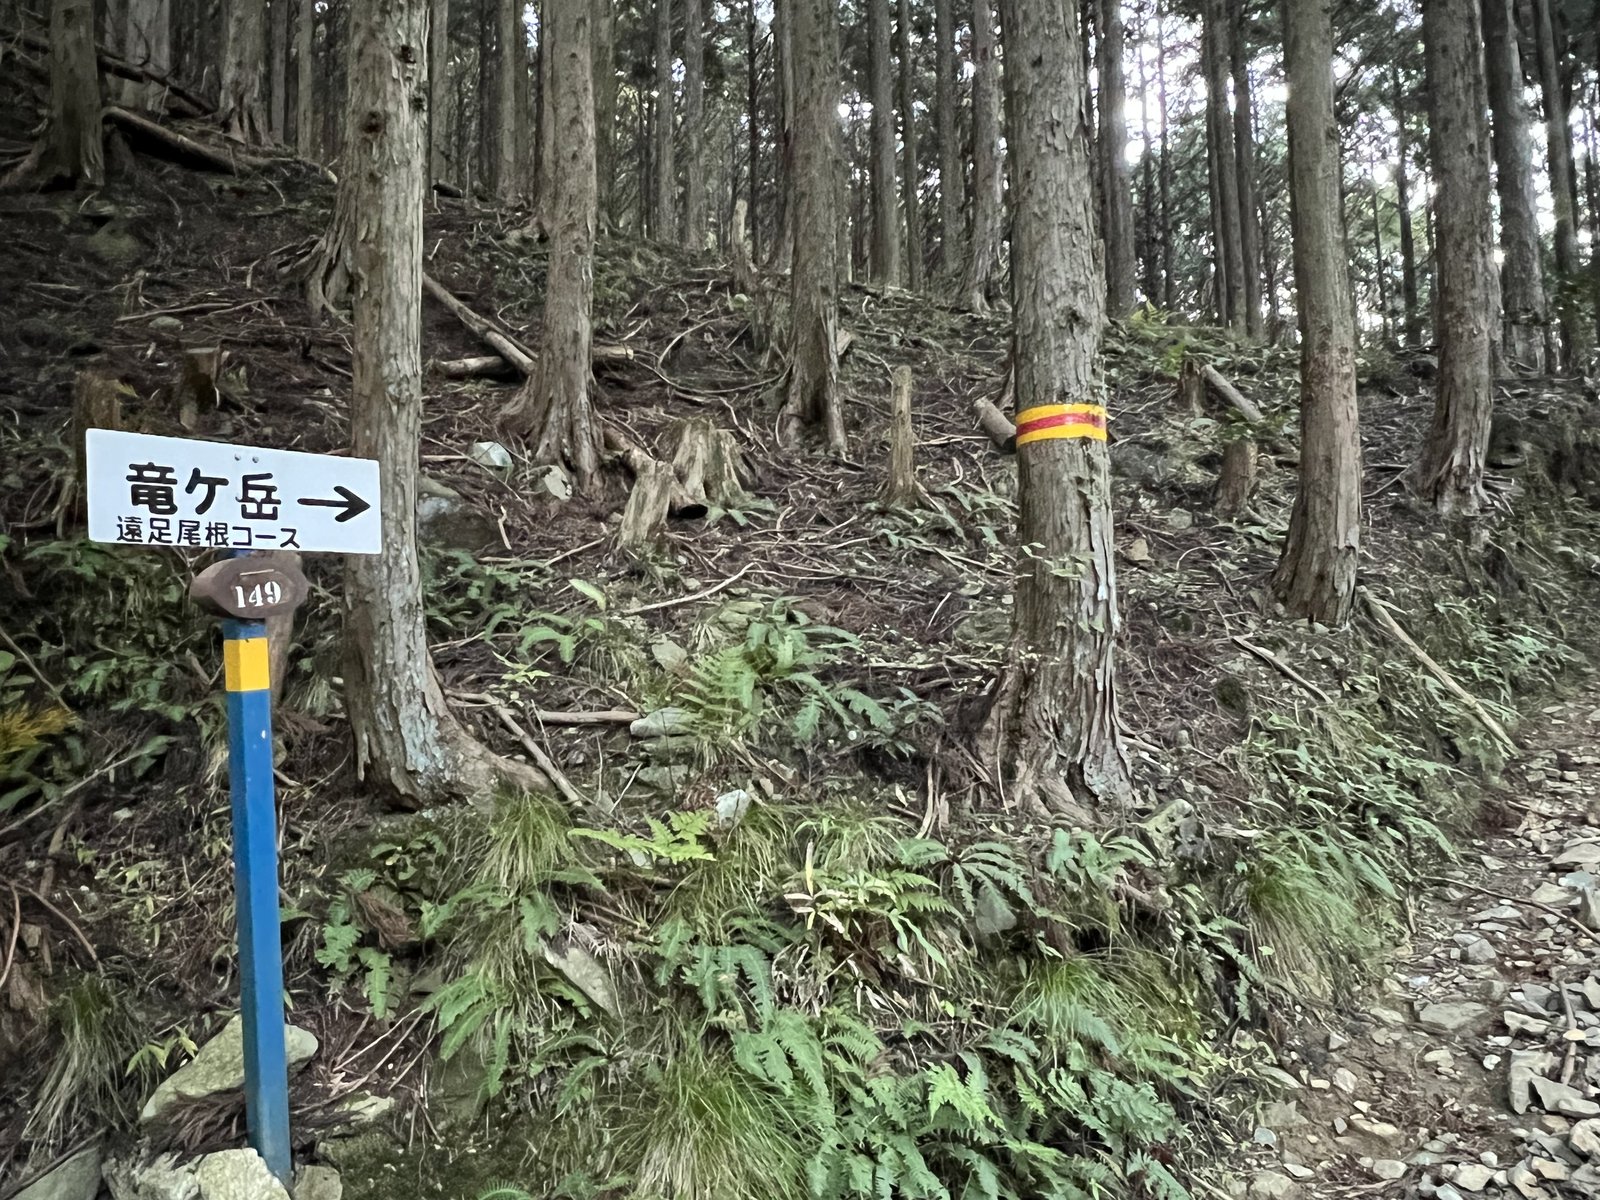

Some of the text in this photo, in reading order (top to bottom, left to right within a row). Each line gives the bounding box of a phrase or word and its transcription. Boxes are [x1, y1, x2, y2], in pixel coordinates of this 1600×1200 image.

[116, 515, 300, 549] 遠足尾根コース
[235, 581, 282, 609] 149
